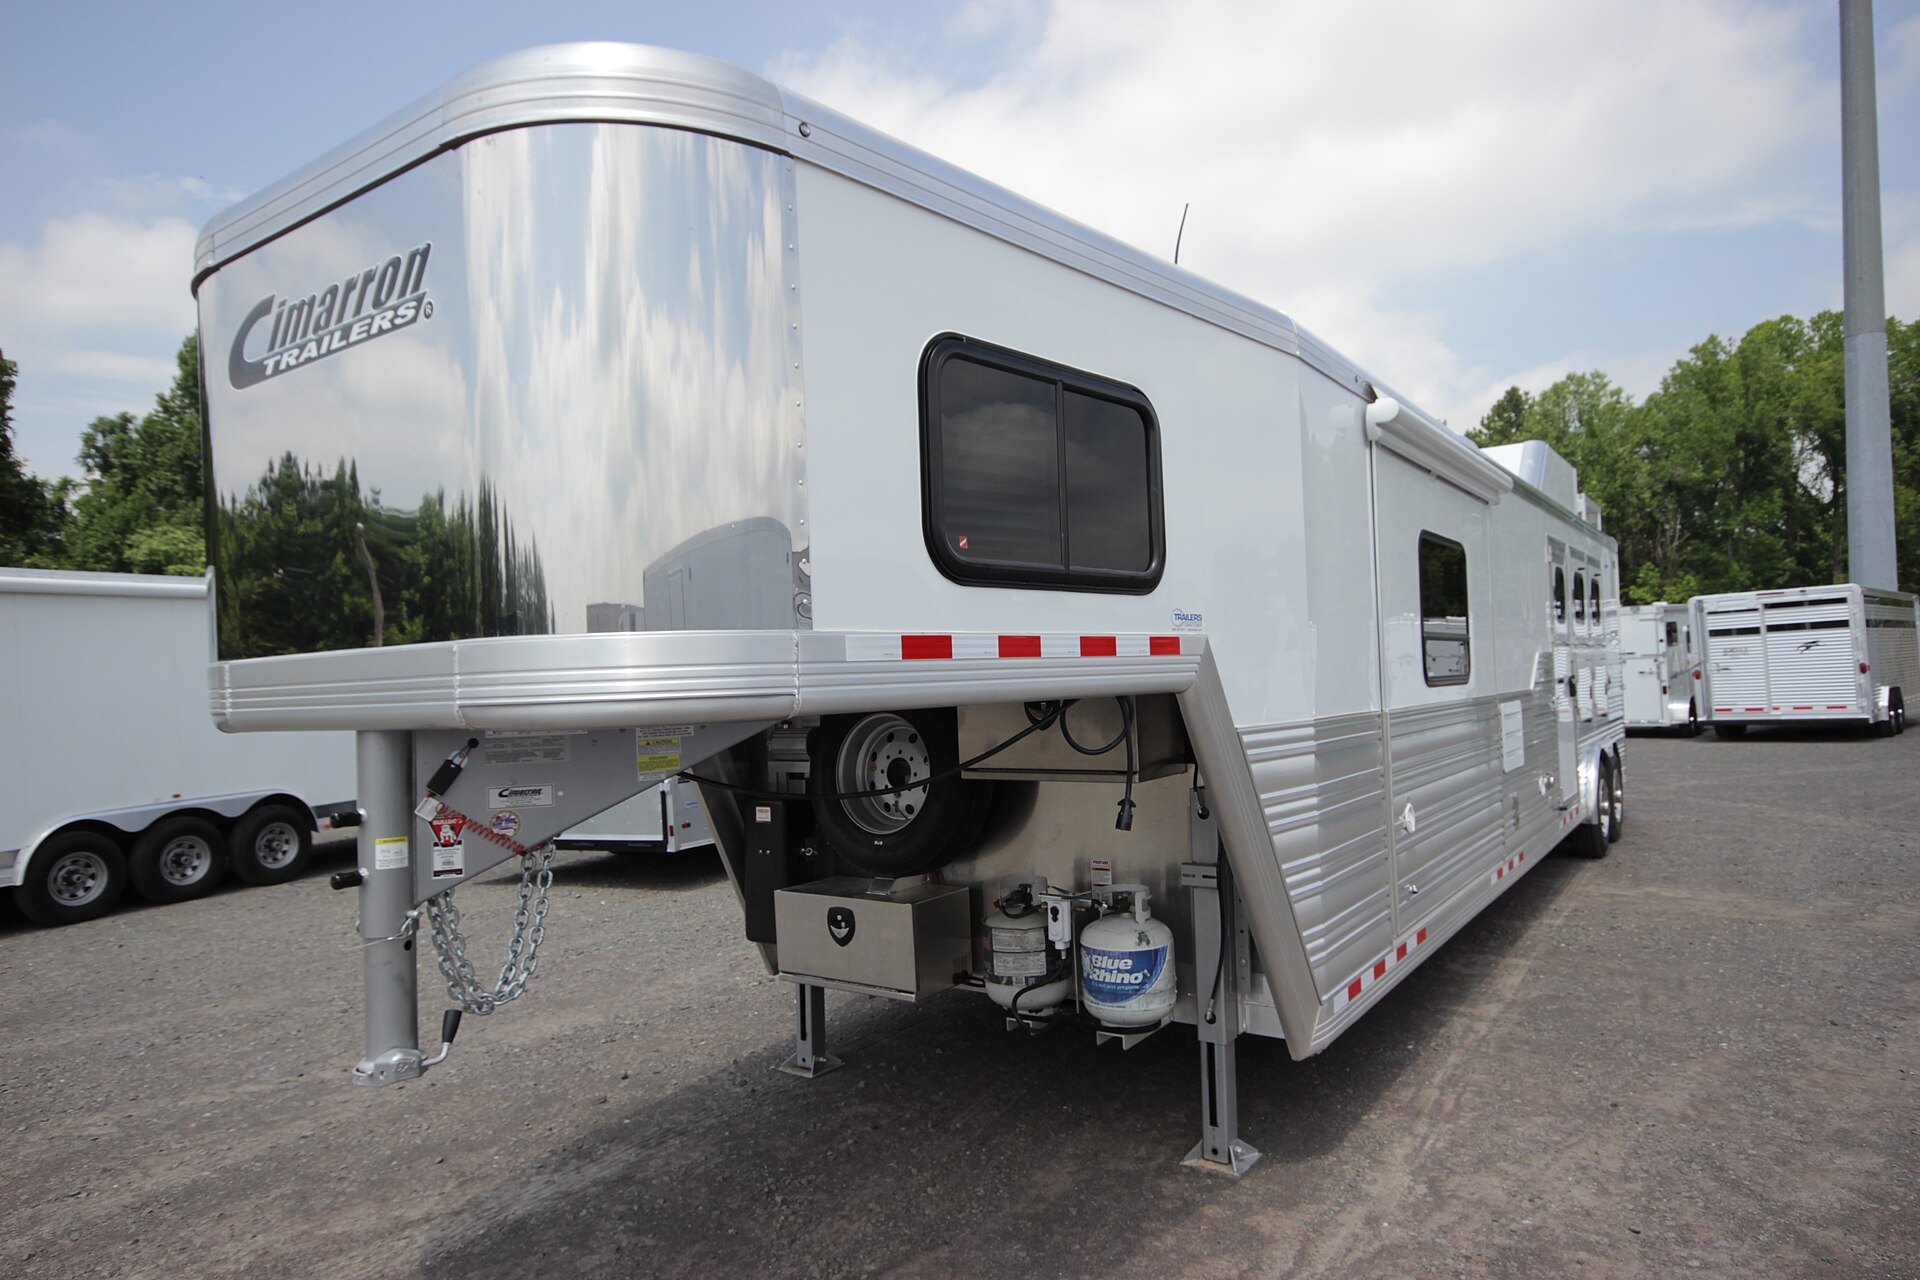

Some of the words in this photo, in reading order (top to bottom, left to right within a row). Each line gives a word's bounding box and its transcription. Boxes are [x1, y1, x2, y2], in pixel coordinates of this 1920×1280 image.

[229, 241, 432, 390] Cimarron
[263, 301, 418, 376] TRAILERS
[1174, 613, 1202, 621] TRAILERS
[1092, 954, 1133, 970] Blue
[1089, 968, 1144, 984] Rhino
